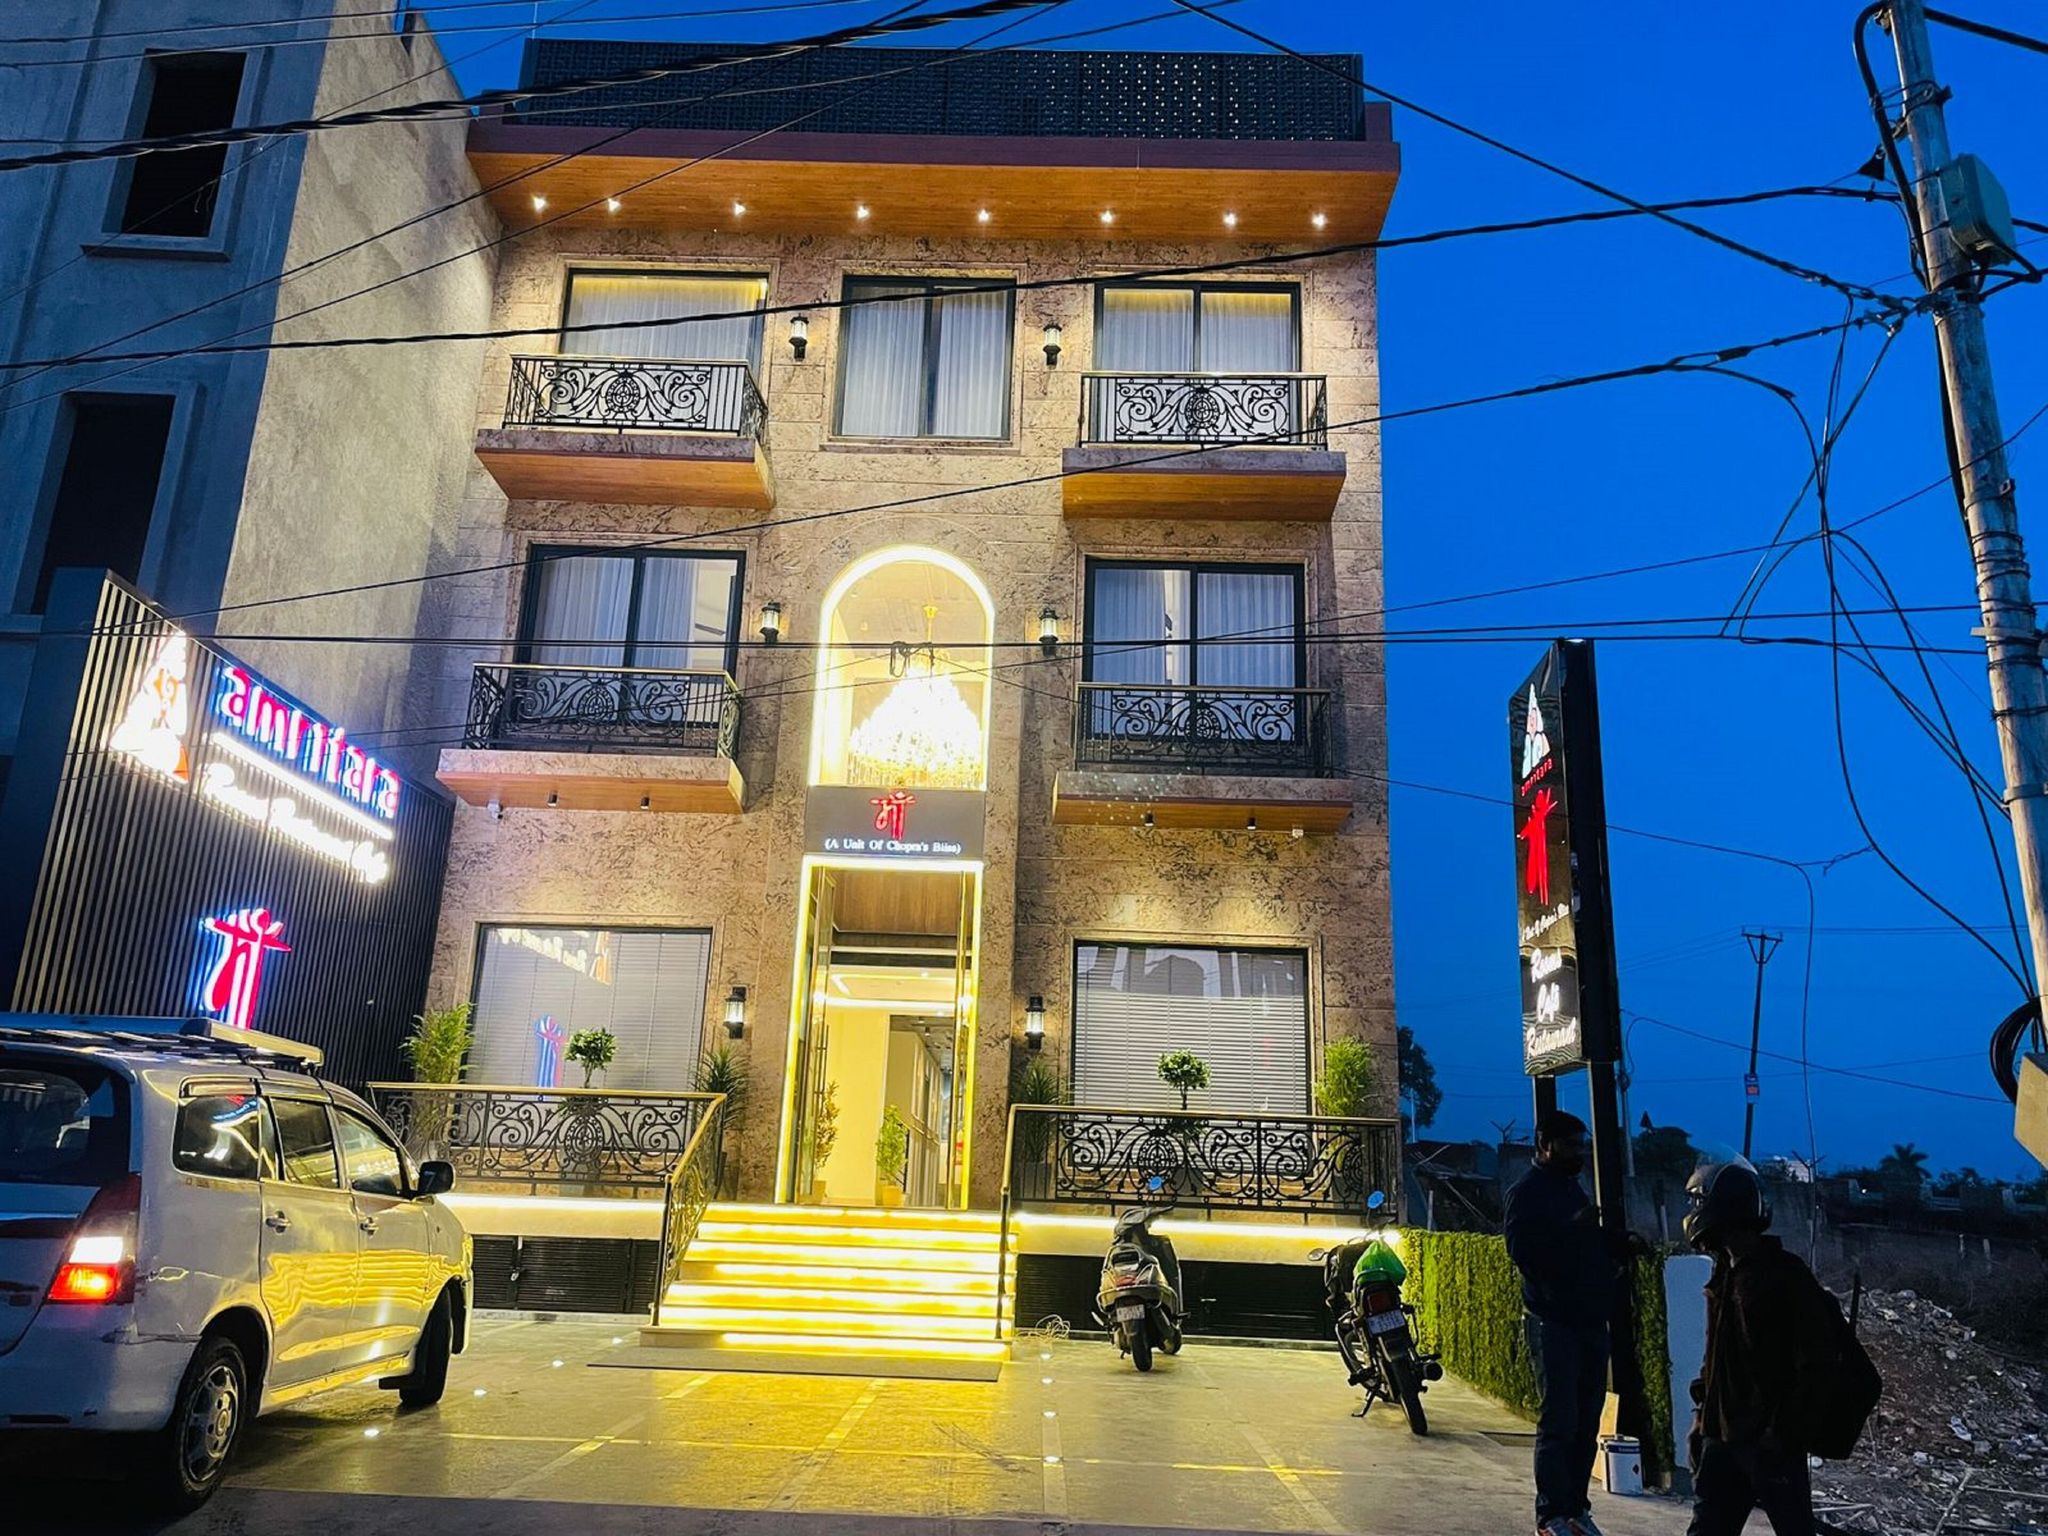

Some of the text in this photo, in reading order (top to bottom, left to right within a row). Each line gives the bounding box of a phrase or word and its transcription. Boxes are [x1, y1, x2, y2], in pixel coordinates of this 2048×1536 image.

[221, 666, 399, 819] amritara
[843, 838, 865, 851] Unit
[869, 840, 883, 851] Of
